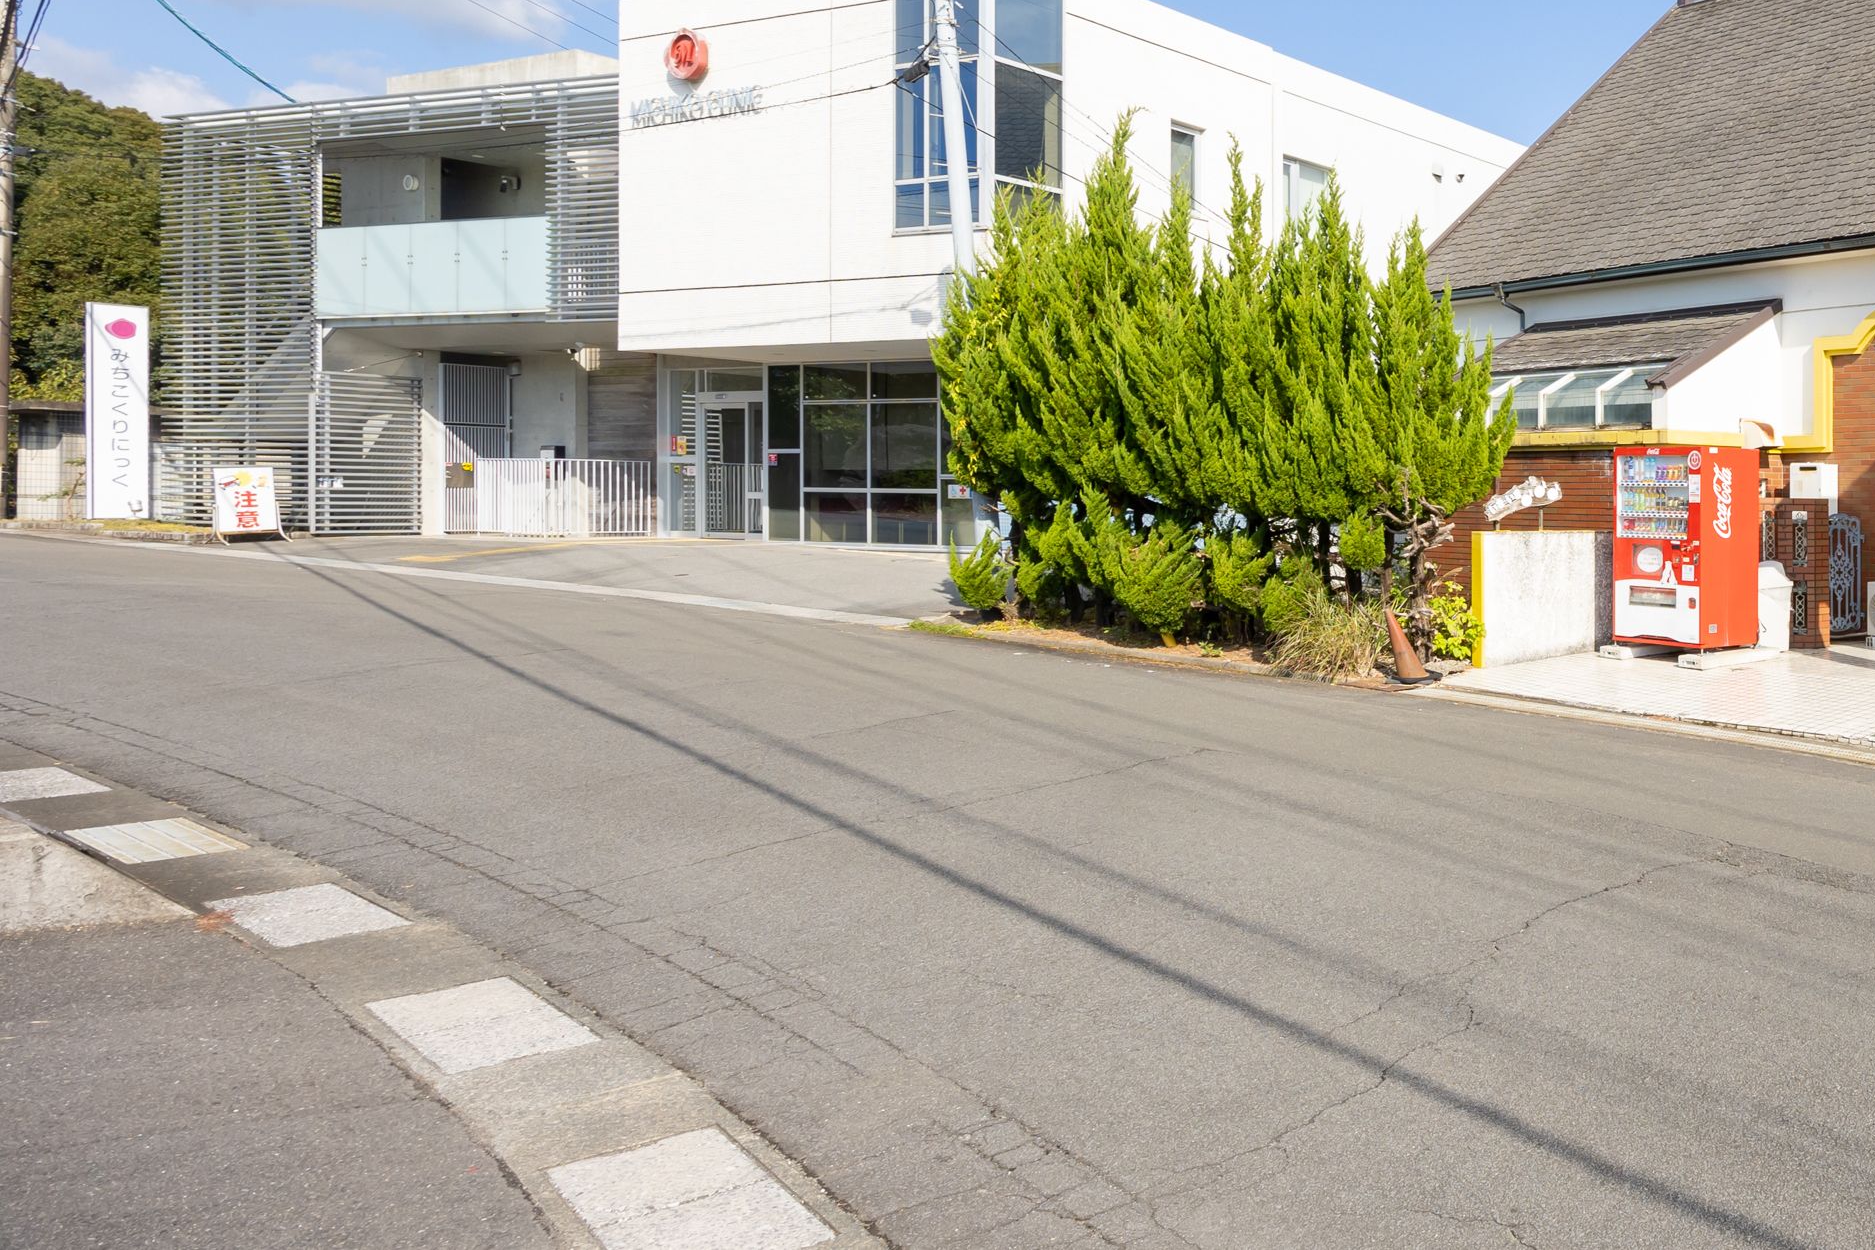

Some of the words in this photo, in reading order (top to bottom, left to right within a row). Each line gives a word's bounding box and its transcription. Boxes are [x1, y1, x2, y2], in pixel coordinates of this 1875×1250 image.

[630, 92, 701, 119] MICHIKO
[707, 85, 763, 111] CLINIC
[234, 490, 260, 529] 注意
